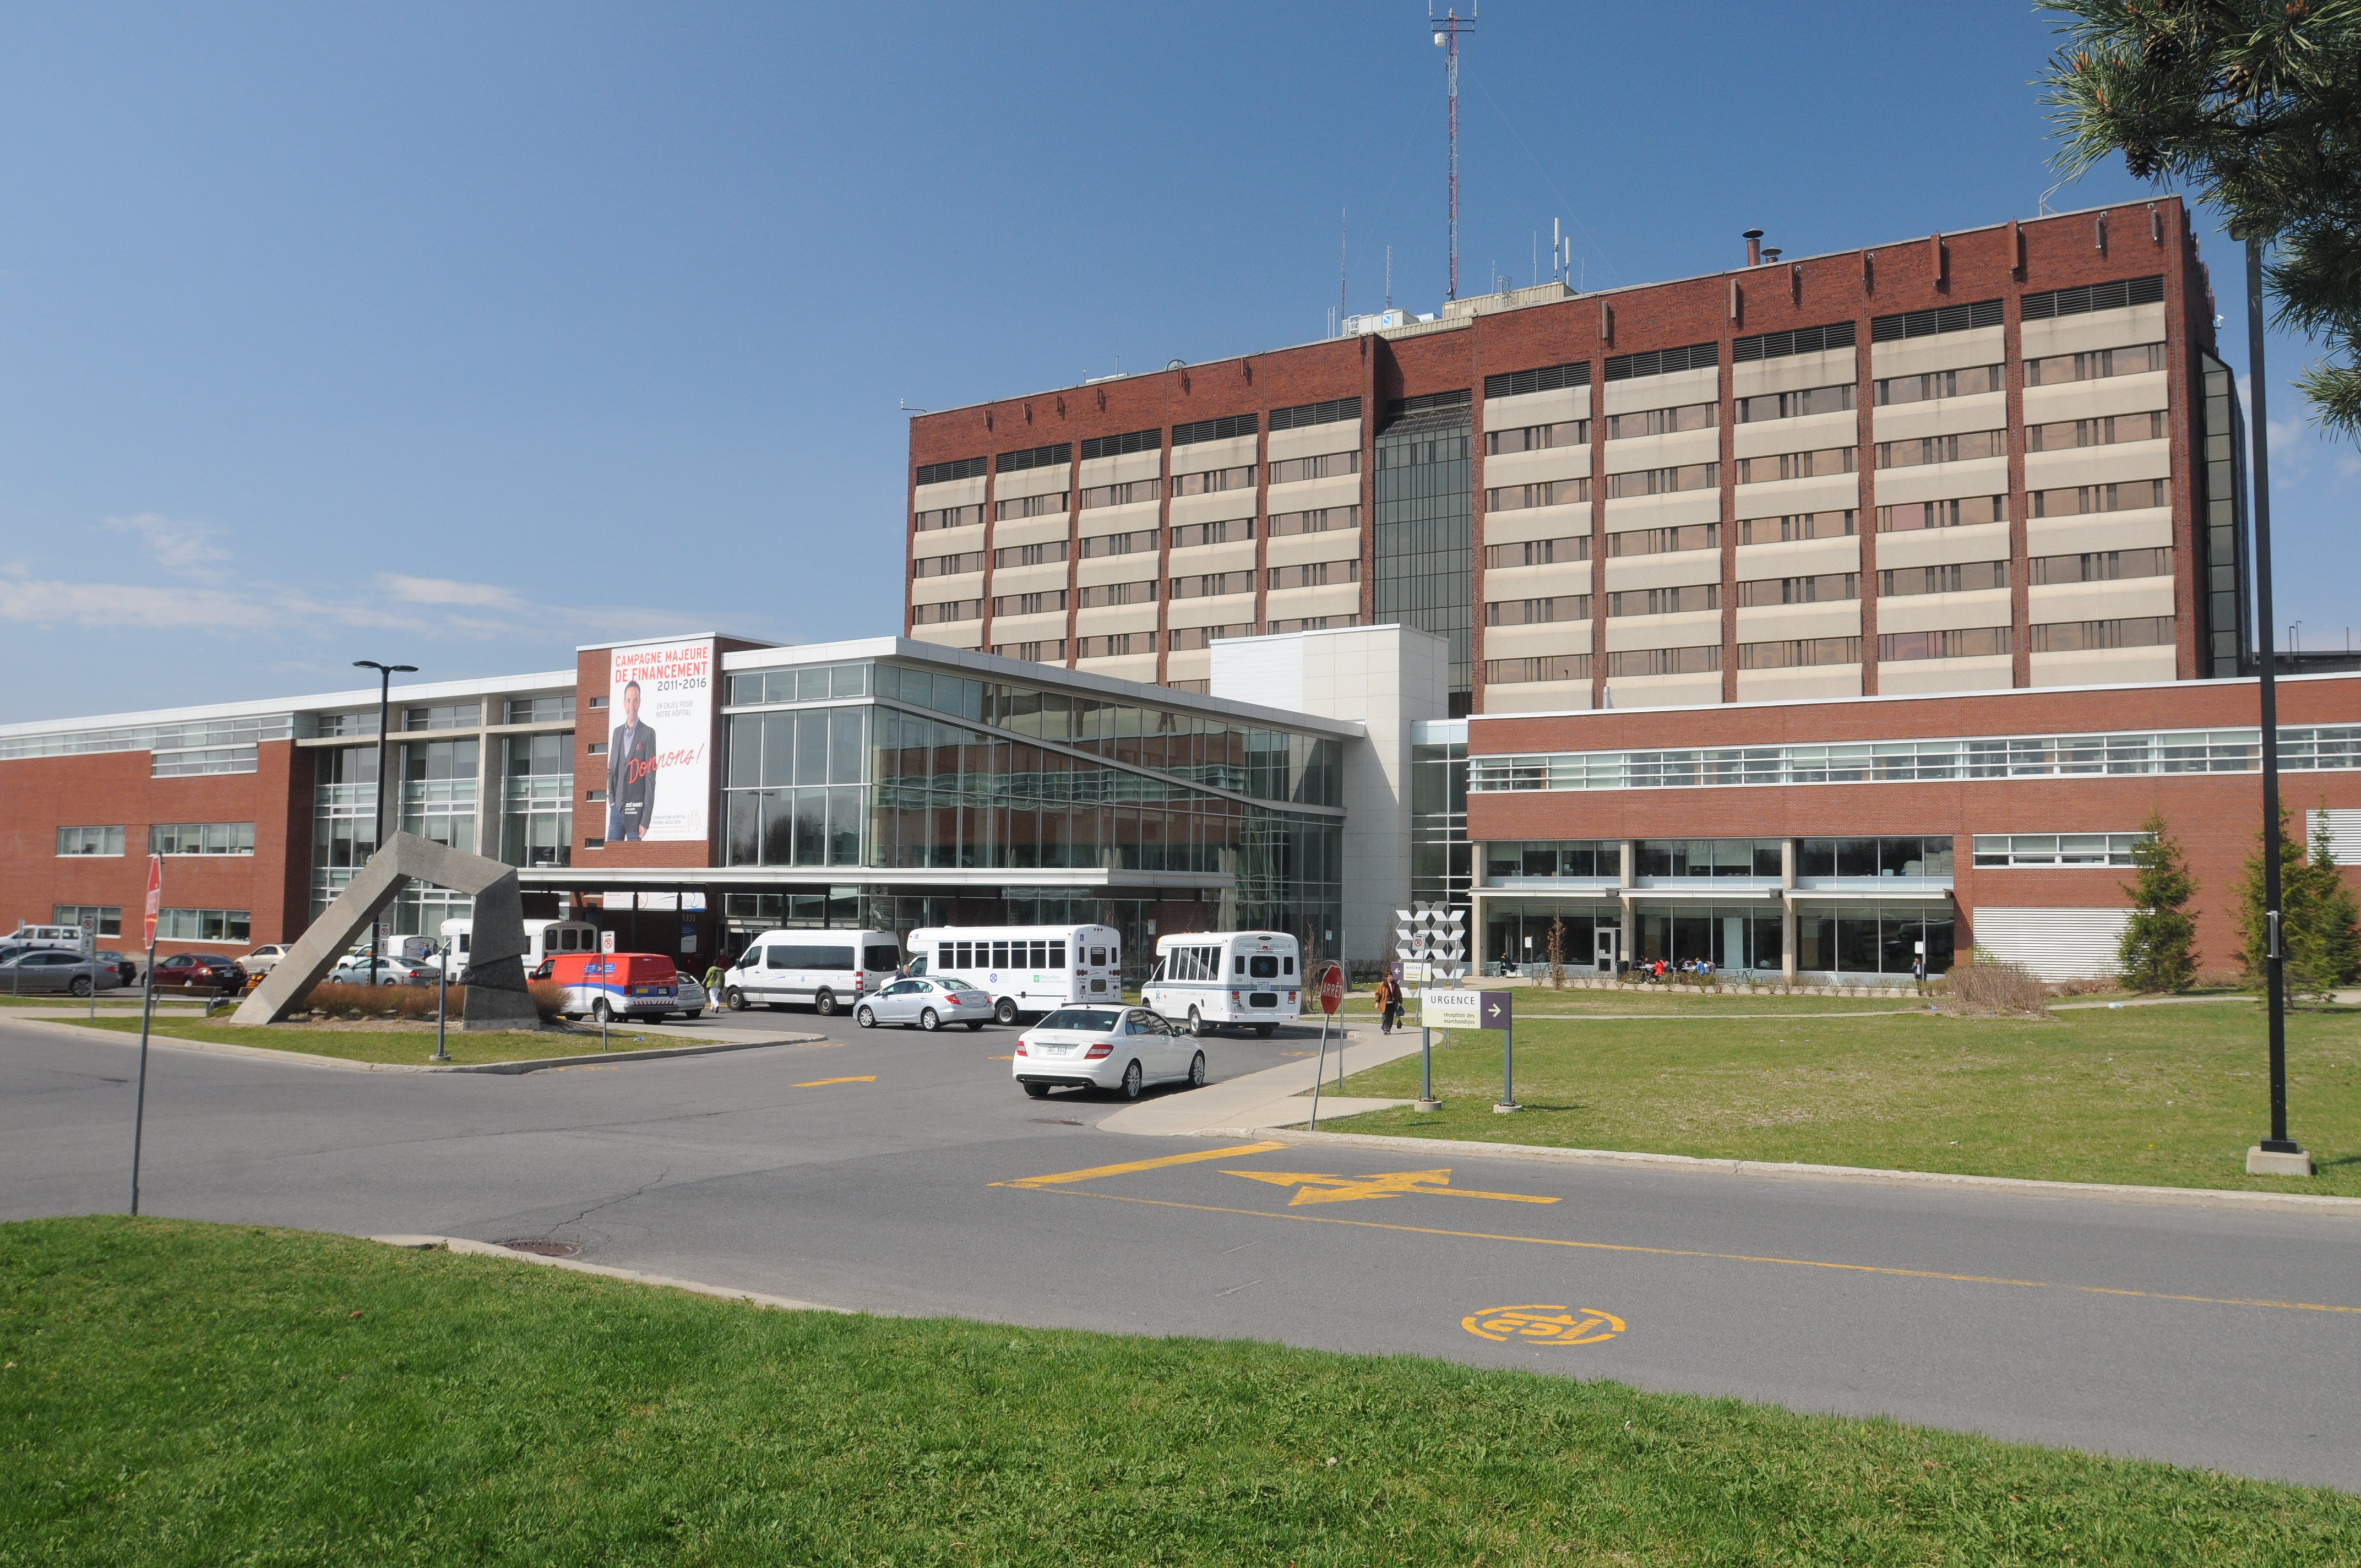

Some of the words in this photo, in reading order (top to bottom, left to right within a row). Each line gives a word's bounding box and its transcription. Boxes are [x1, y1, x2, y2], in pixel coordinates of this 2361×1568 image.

[616, 651, 662, 667] CAMPAGNE
[665, 647, 708, 662] MAJEURE
[615, 668, 628, 683] DE
[632, 661, 707, 682] FINANCEMENT
[657, 677, 706, 691] 2011-2016
[1322, 981, 1342, 999] ARRÊT
[1430, 995, 1475, 1005] URGENCE
